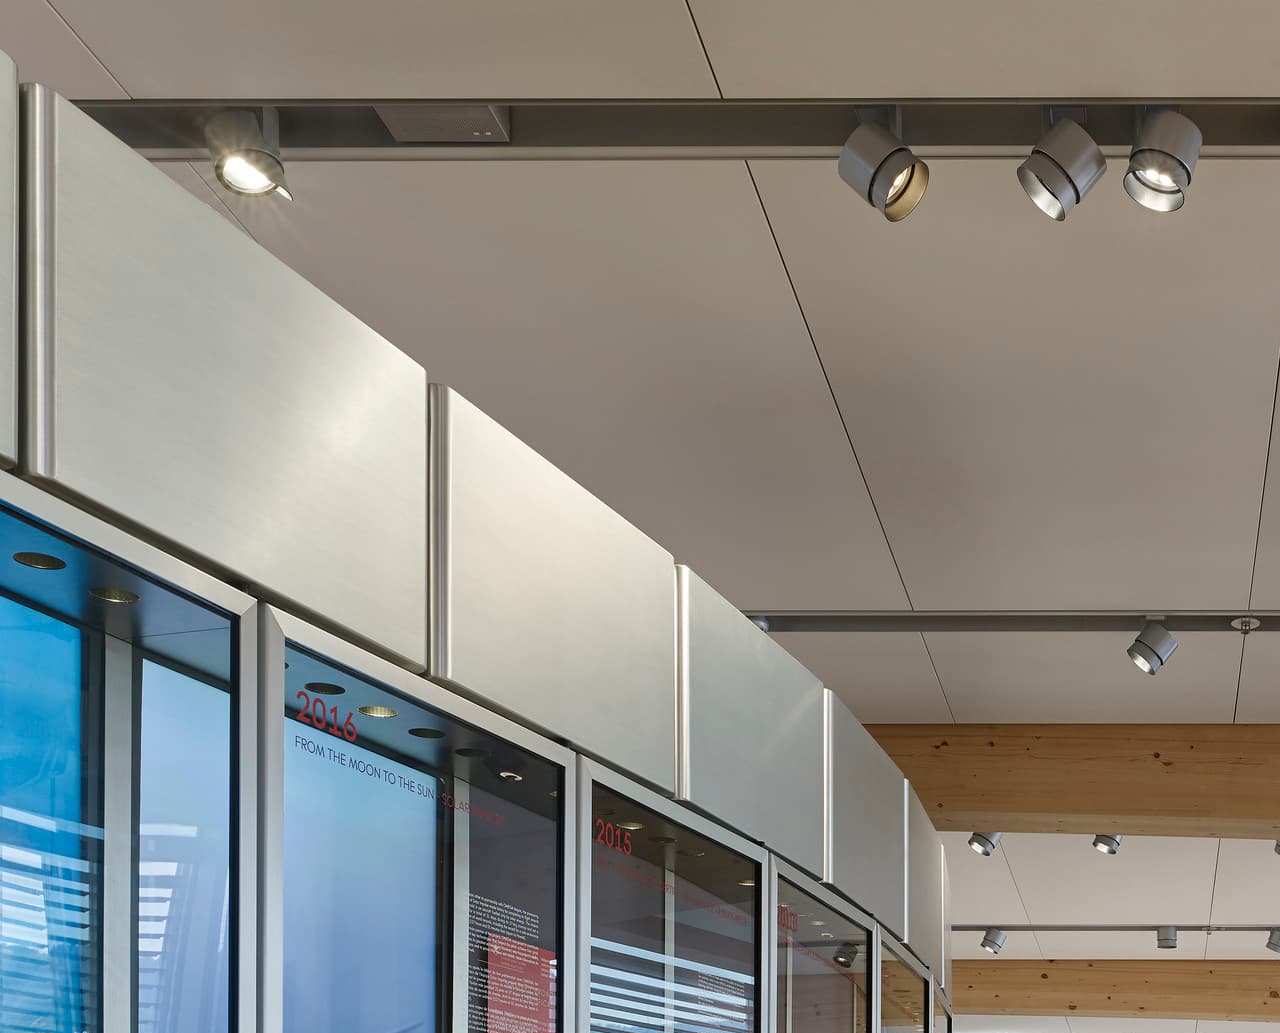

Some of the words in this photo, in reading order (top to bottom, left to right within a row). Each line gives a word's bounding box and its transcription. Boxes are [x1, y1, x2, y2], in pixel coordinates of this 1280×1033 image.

[296, 691, 357, 742] 2016
[295, 735, 325, 758] FROM
[328, 748, 346, 766] THE
[349, 758, 381, 779] MOON
[383, 769, 396, 785] TO
[398, 775, 415, 793] THE
[417, 783, 435, 799] SUN
[596, 818, 632, 856] 2015
